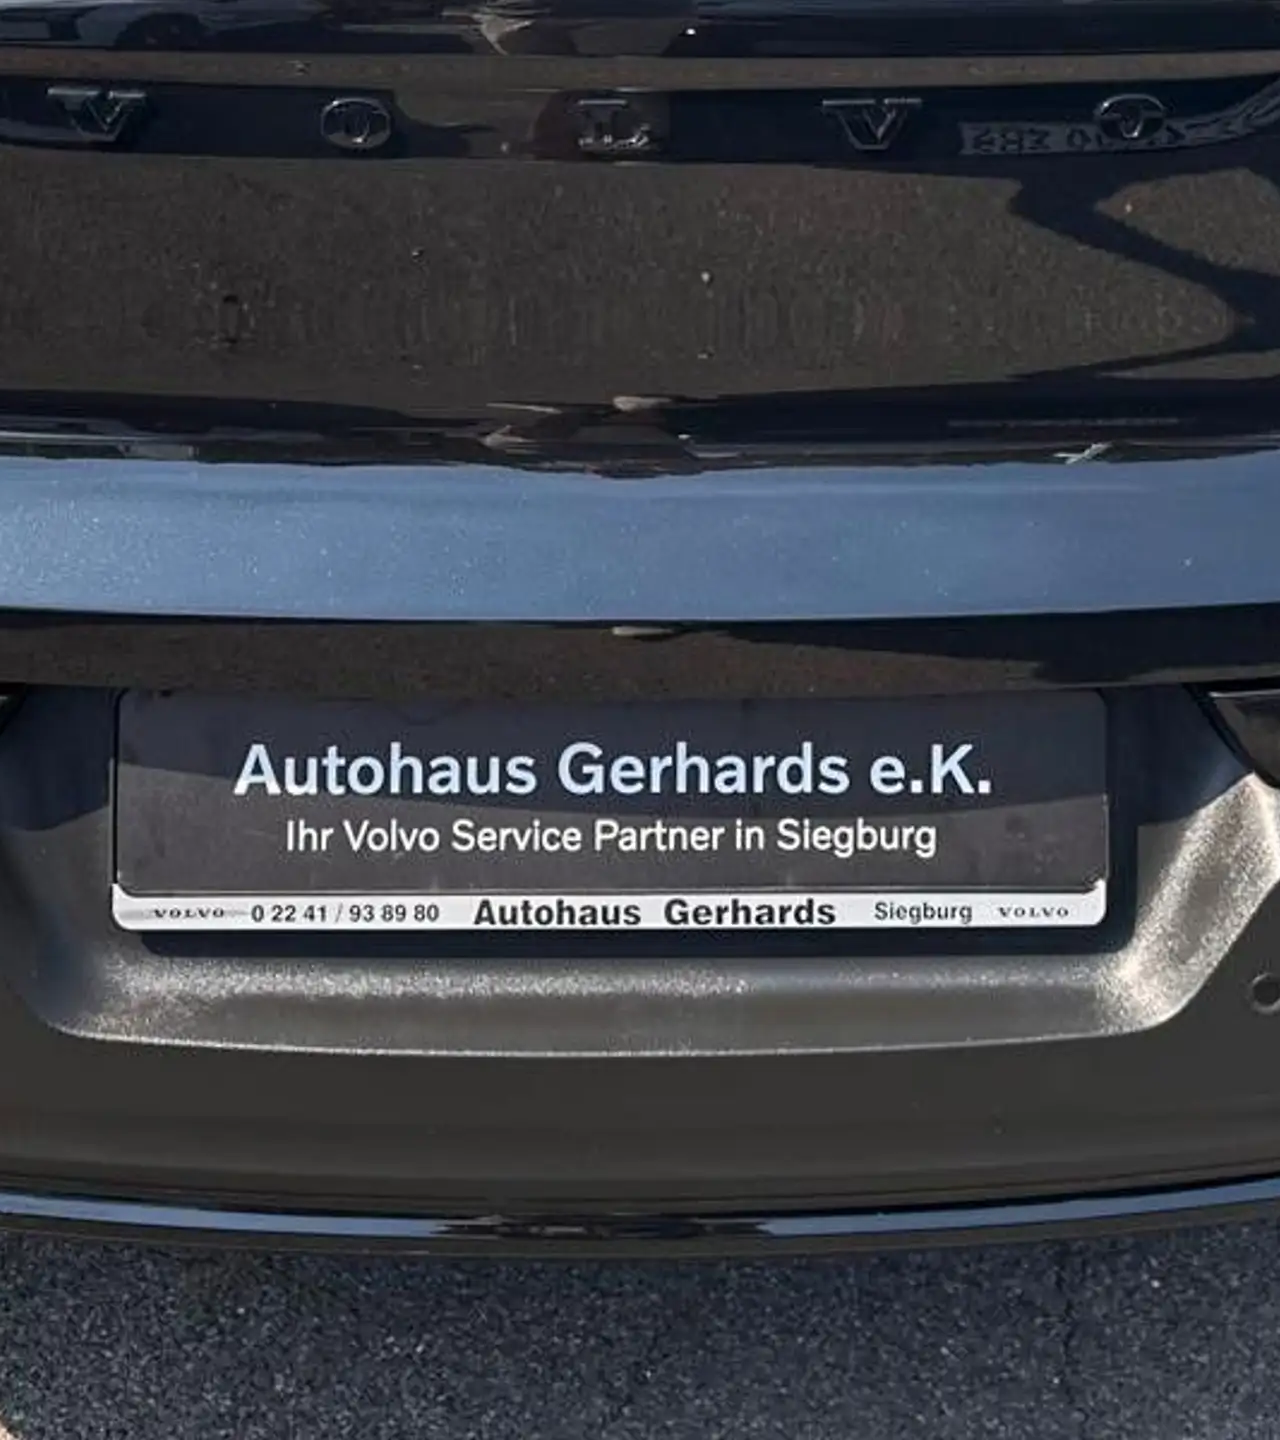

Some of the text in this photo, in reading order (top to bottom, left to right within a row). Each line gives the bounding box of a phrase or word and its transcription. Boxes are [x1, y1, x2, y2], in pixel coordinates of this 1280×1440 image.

[46, 86, 1167, 152] VOLVO
[233, 741, 992, 796] Autohaus Gerhards e.K.
[286, 817, 937, 859] Ihr Volvo Service Partner in Siegburg
[152, 908, 225, 919] VOLVO
[250, 904, 265, 923] 0
[271, 904, 297, 922] 22
[303, 904, 326, 922] 41
[349, 904, 375, 923] 93
[381, 904, 407, 922] 89
[413, 904, 440, 922] 80
[473, 899, 642, 926] Autohaus
[664, 898, 836, 926] Gerhards
[873, 901, 973, 923] Siegburg
[998, 907, 1070, 918] VOLVO
